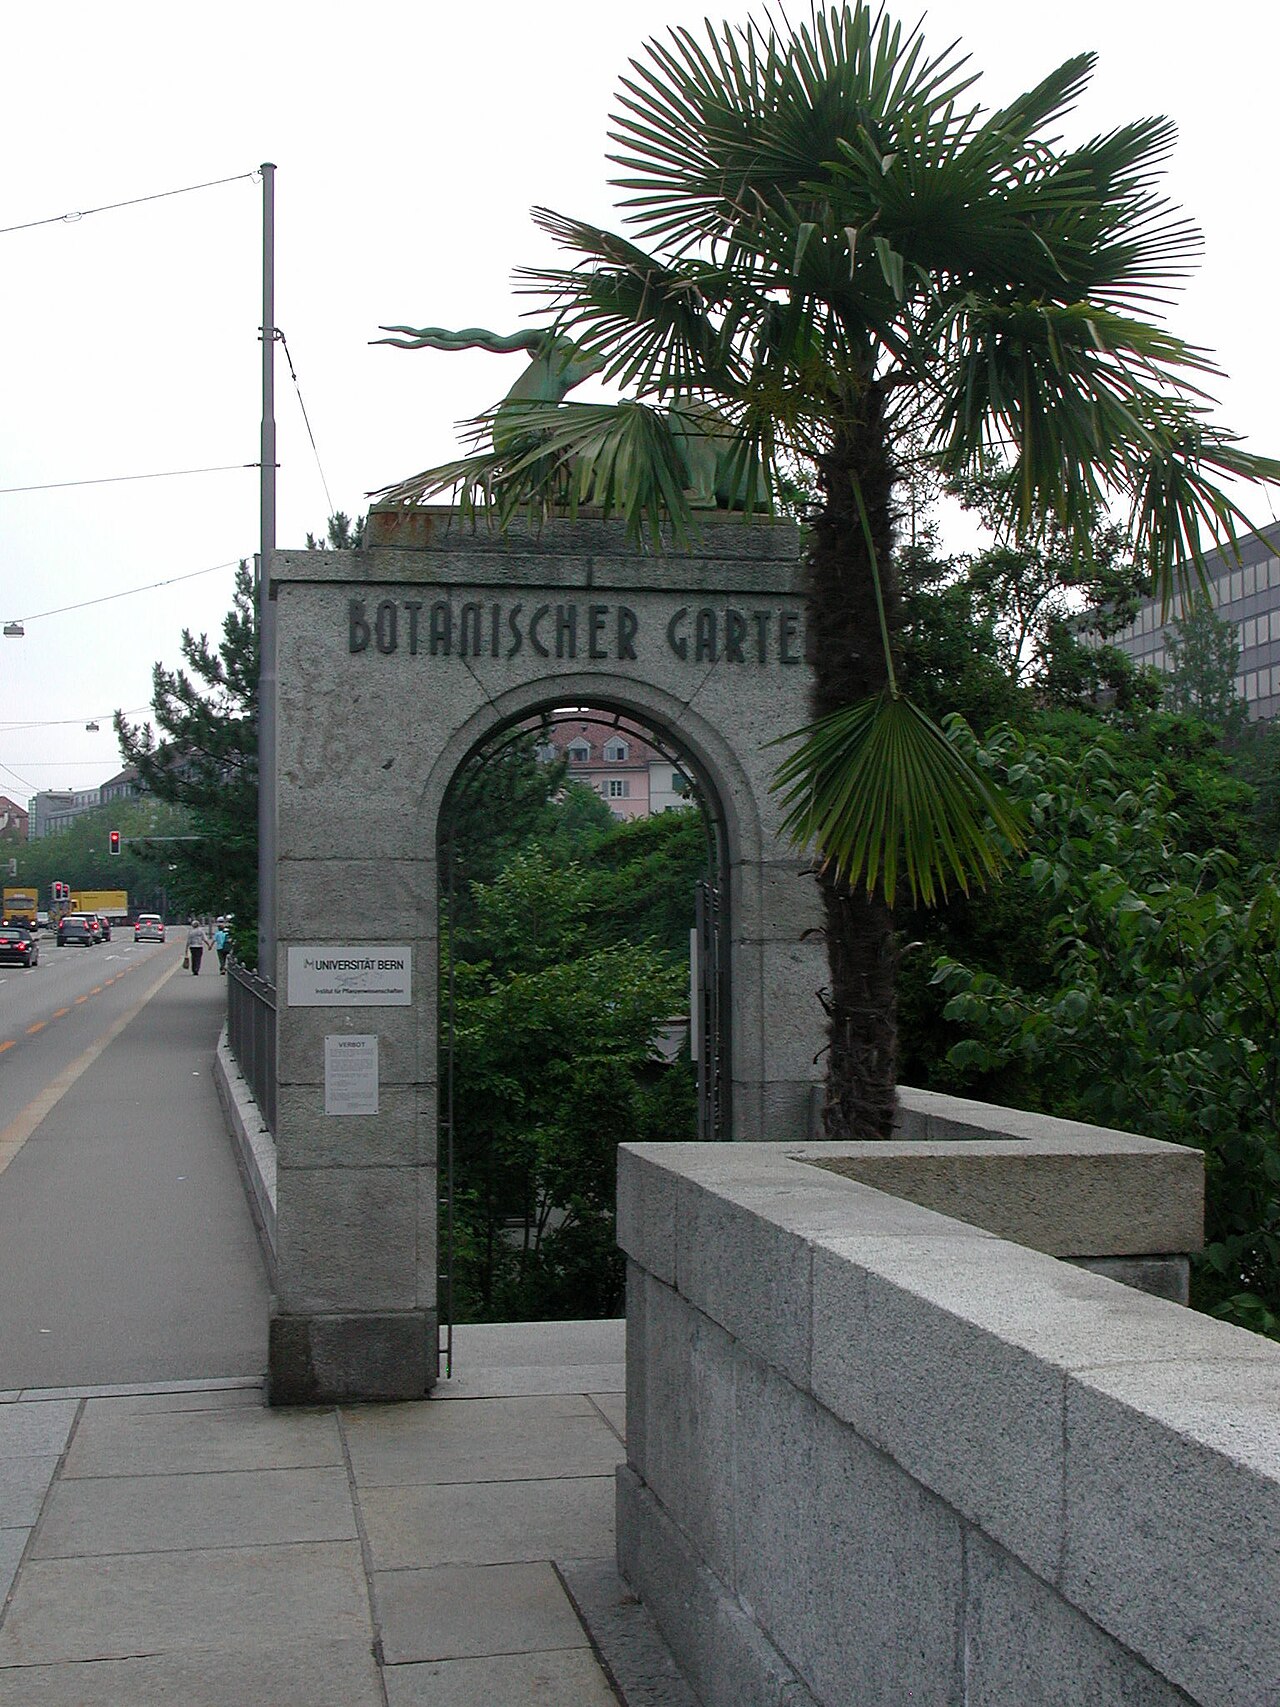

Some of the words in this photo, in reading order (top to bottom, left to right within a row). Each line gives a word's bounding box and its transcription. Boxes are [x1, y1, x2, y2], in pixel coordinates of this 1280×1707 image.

[348, 598, 638, 660] BOTANISCHER
[315, 957, 376, 971] UNIVERSITÄT
[378, 960, 404, 971] BERN
